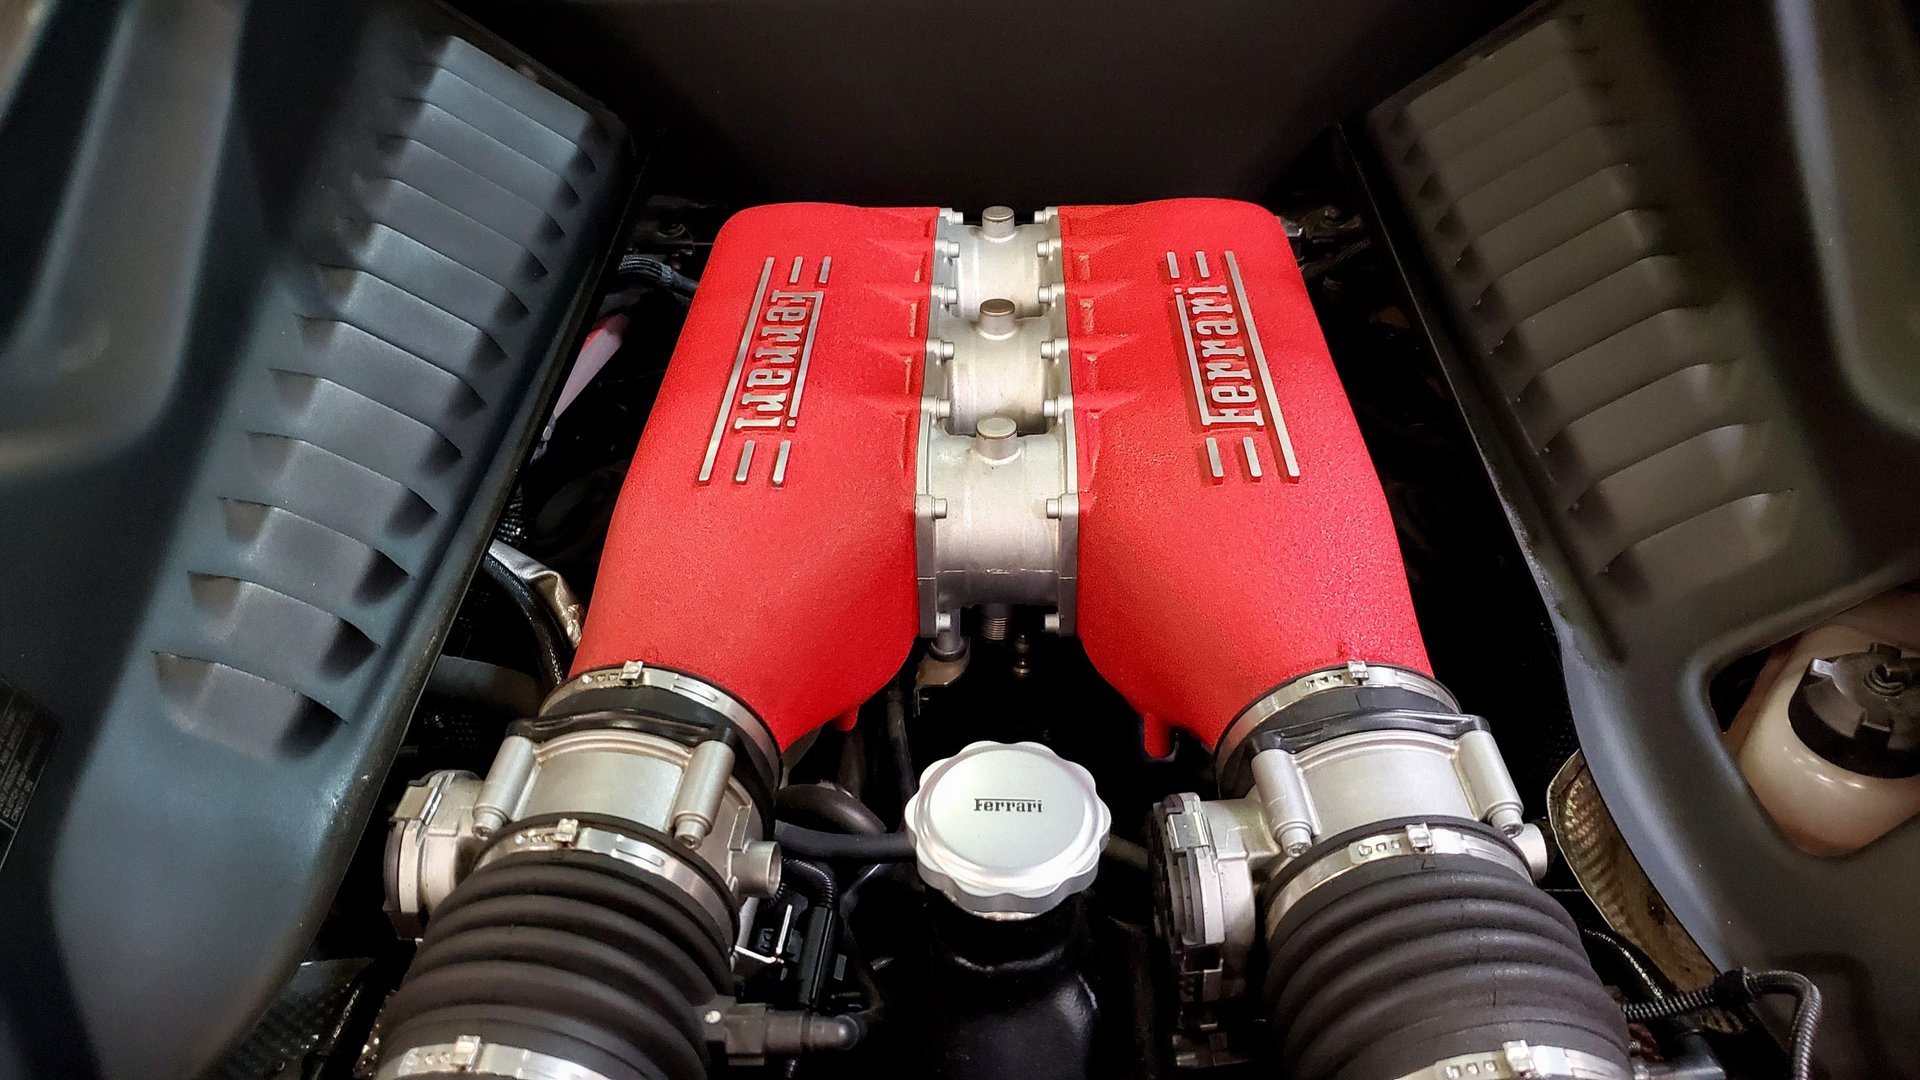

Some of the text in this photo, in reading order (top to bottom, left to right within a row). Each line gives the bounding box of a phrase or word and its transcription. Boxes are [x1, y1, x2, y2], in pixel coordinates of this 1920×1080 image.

[734, 289, 825, 429] Ferrari
[1173, 285, 1265, 426] Ferrari
[973, 798, 1043, 813] Ferrari
